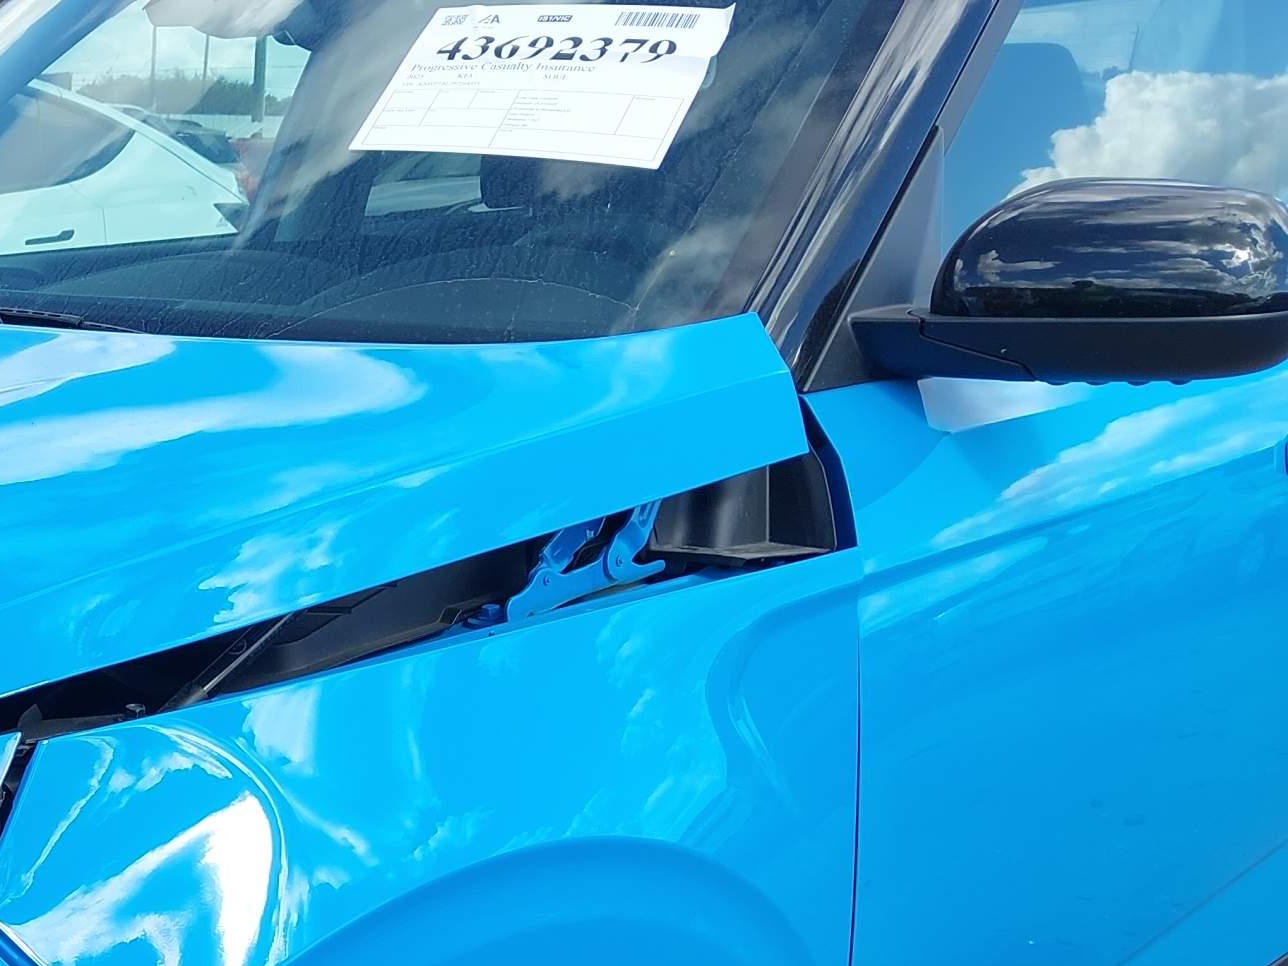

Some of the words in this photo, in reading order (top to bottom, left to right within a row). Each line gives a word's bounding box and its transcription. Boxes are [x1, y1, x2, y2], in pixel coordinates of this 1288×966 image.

[437, 35, 677, 63] 43692379
[411, 63, 478, 72] Progressive
[481, 61, 532, 72] Casualty
[536, 63, 596, 72] Insurance
